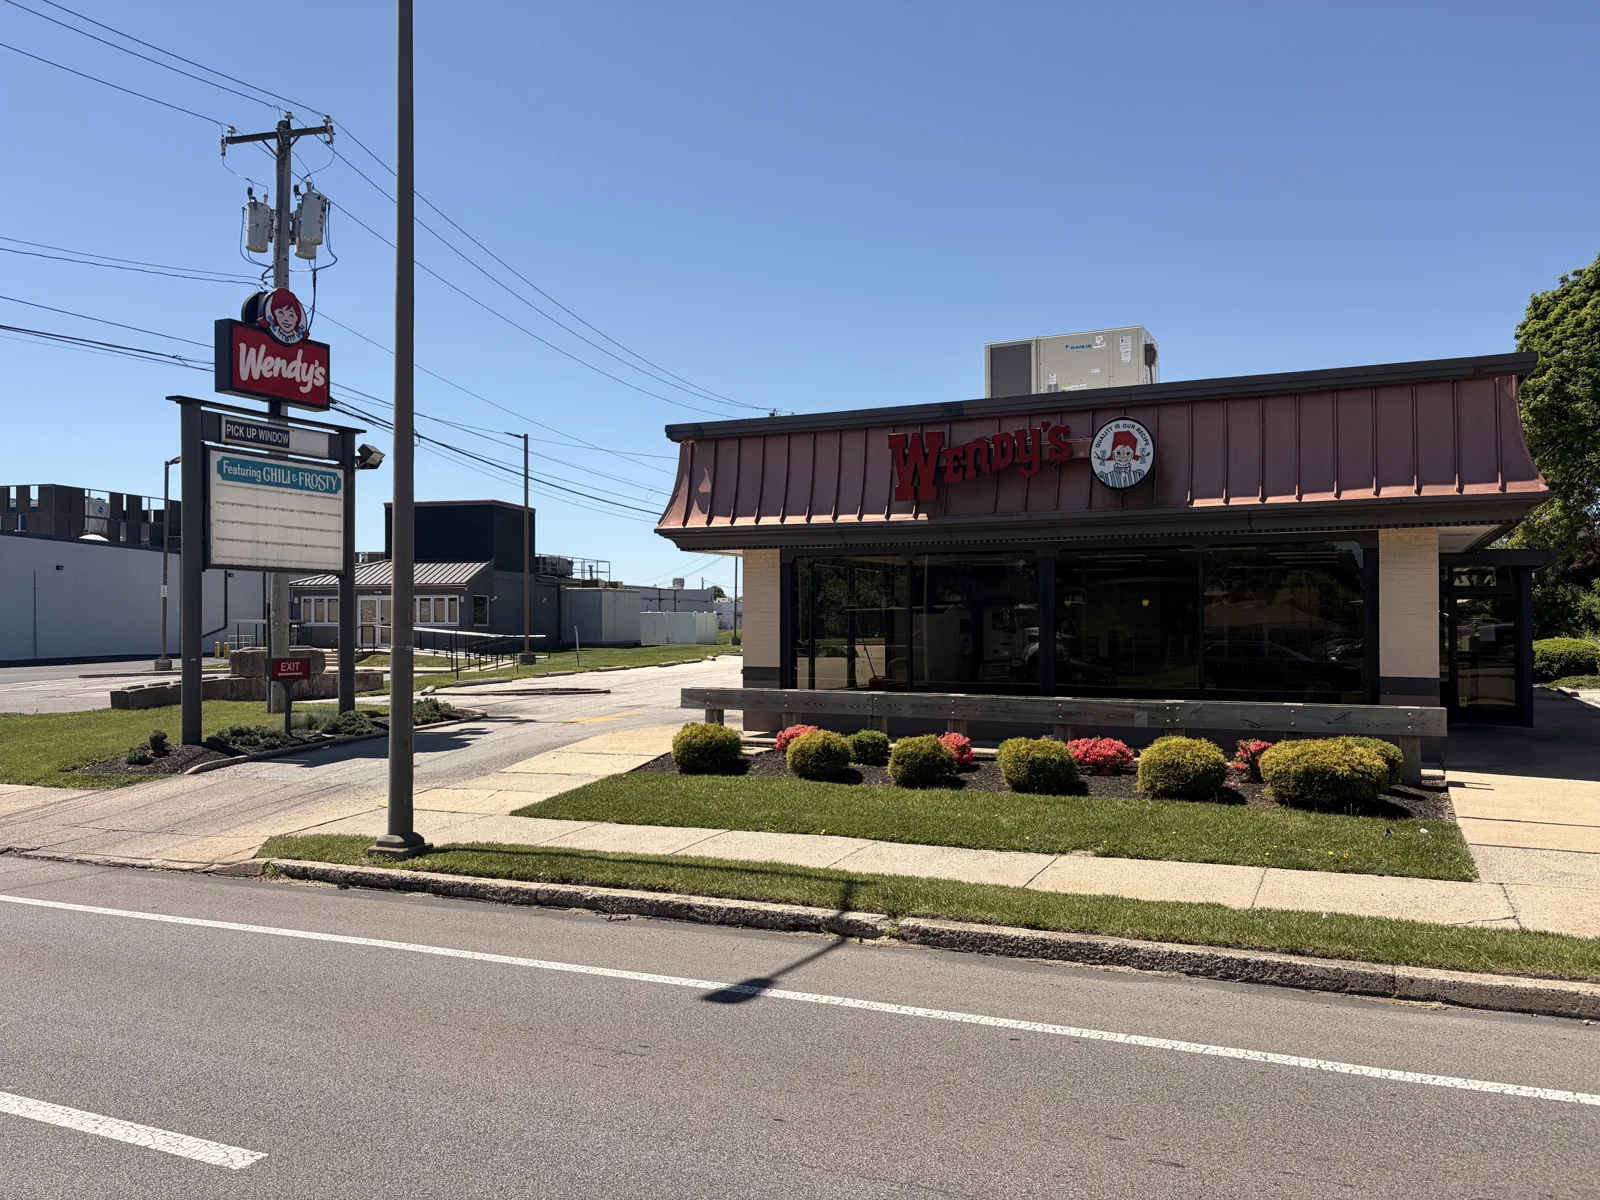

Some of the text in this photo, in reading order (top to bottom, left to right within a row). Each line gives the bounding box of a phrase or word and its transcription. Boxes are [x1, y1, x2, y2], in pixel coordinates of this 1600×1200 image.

[238, 342, 326, 394] Wendy's
[226, 424, 289, 444] PICK UP WINDOW
[1095, 426, 1113, 448] QUALITY
[1135, 427, 1150, 447] RECIPE
[223, 460, 338, 491] Featuring CHILI & FROSTY
[280, 661, 301, 672] EXIT
